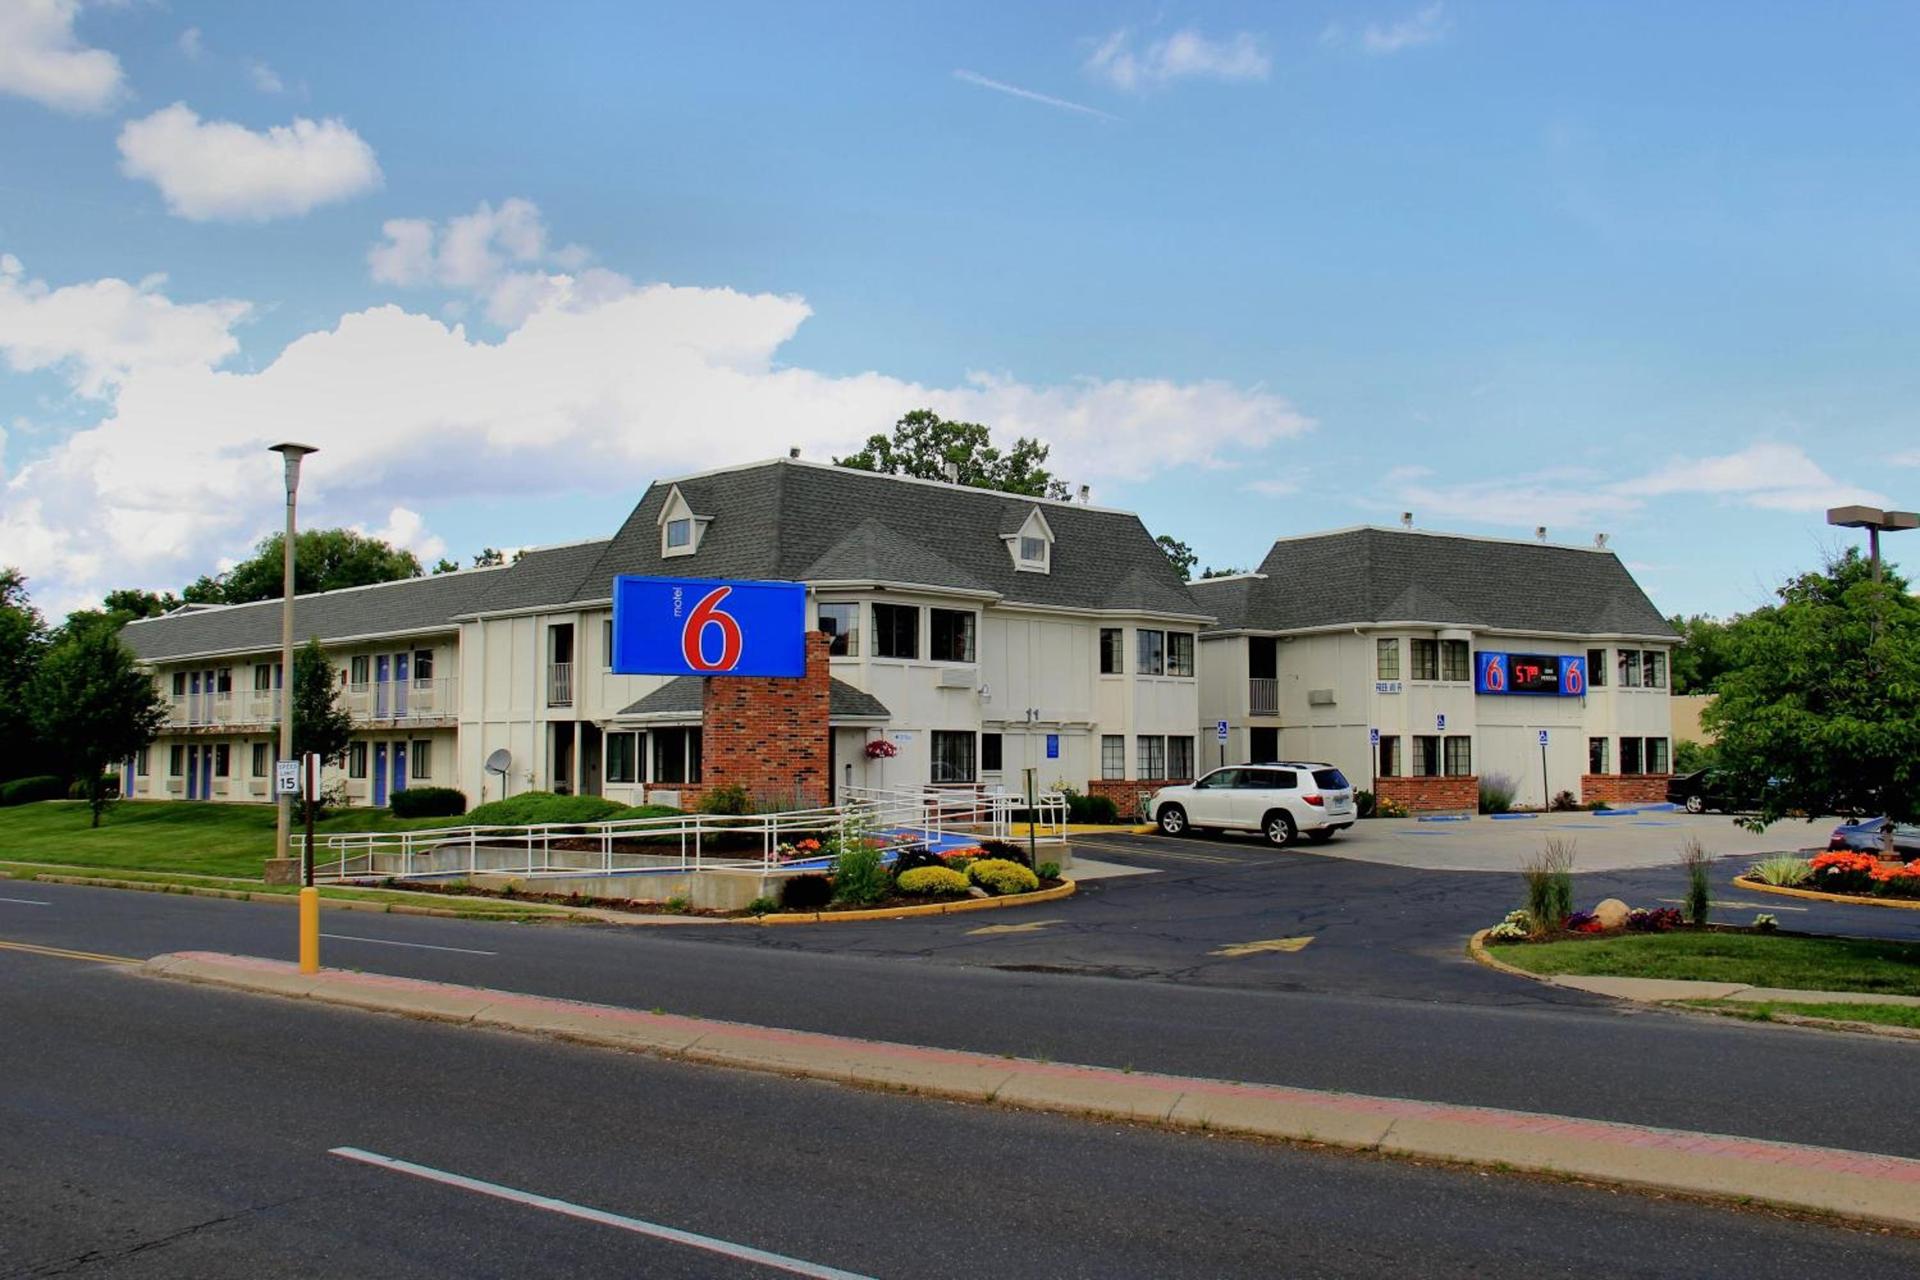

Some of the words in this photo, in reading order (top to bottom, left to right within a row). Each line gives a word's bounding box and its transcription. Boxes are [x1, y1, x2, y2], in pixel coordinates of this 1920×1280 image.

[672, 586, 683, 617] motel
[682, 586, 743, 671] 6
[1486, 655, 1504, 691] 6
[1565, 659, 1582, 694] 6
[280, 777, 295, 789] 15
